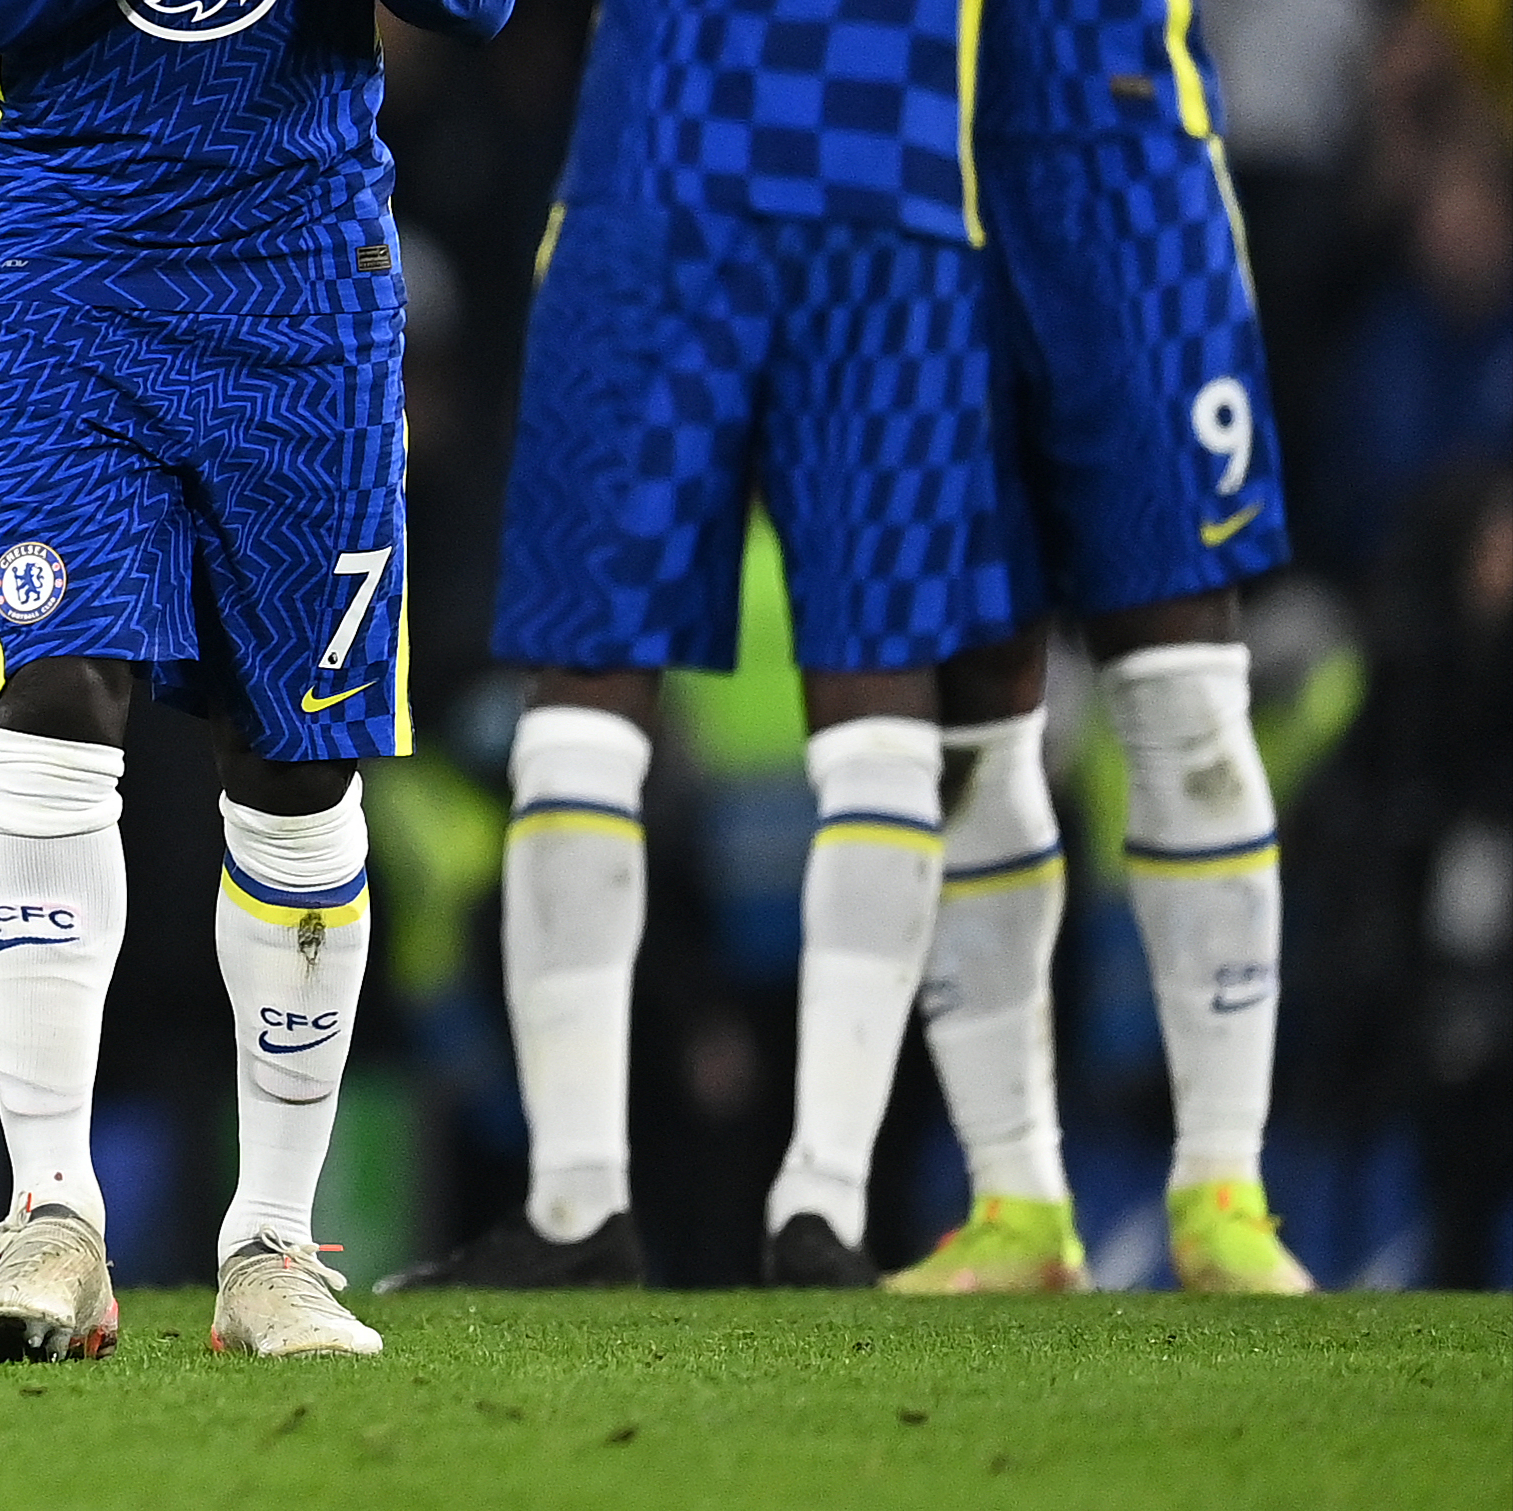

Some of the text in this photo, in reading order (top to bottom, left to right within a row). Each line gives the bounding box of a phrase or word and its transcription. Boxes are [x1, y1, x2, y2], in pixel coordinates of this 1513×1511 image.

[1192, 375, 1253, 496] 9
[0, 545, 47, 569] CHELSEA
[317, 546, 392, 670] 7
[260, 1007, 339, 1032] CFC
